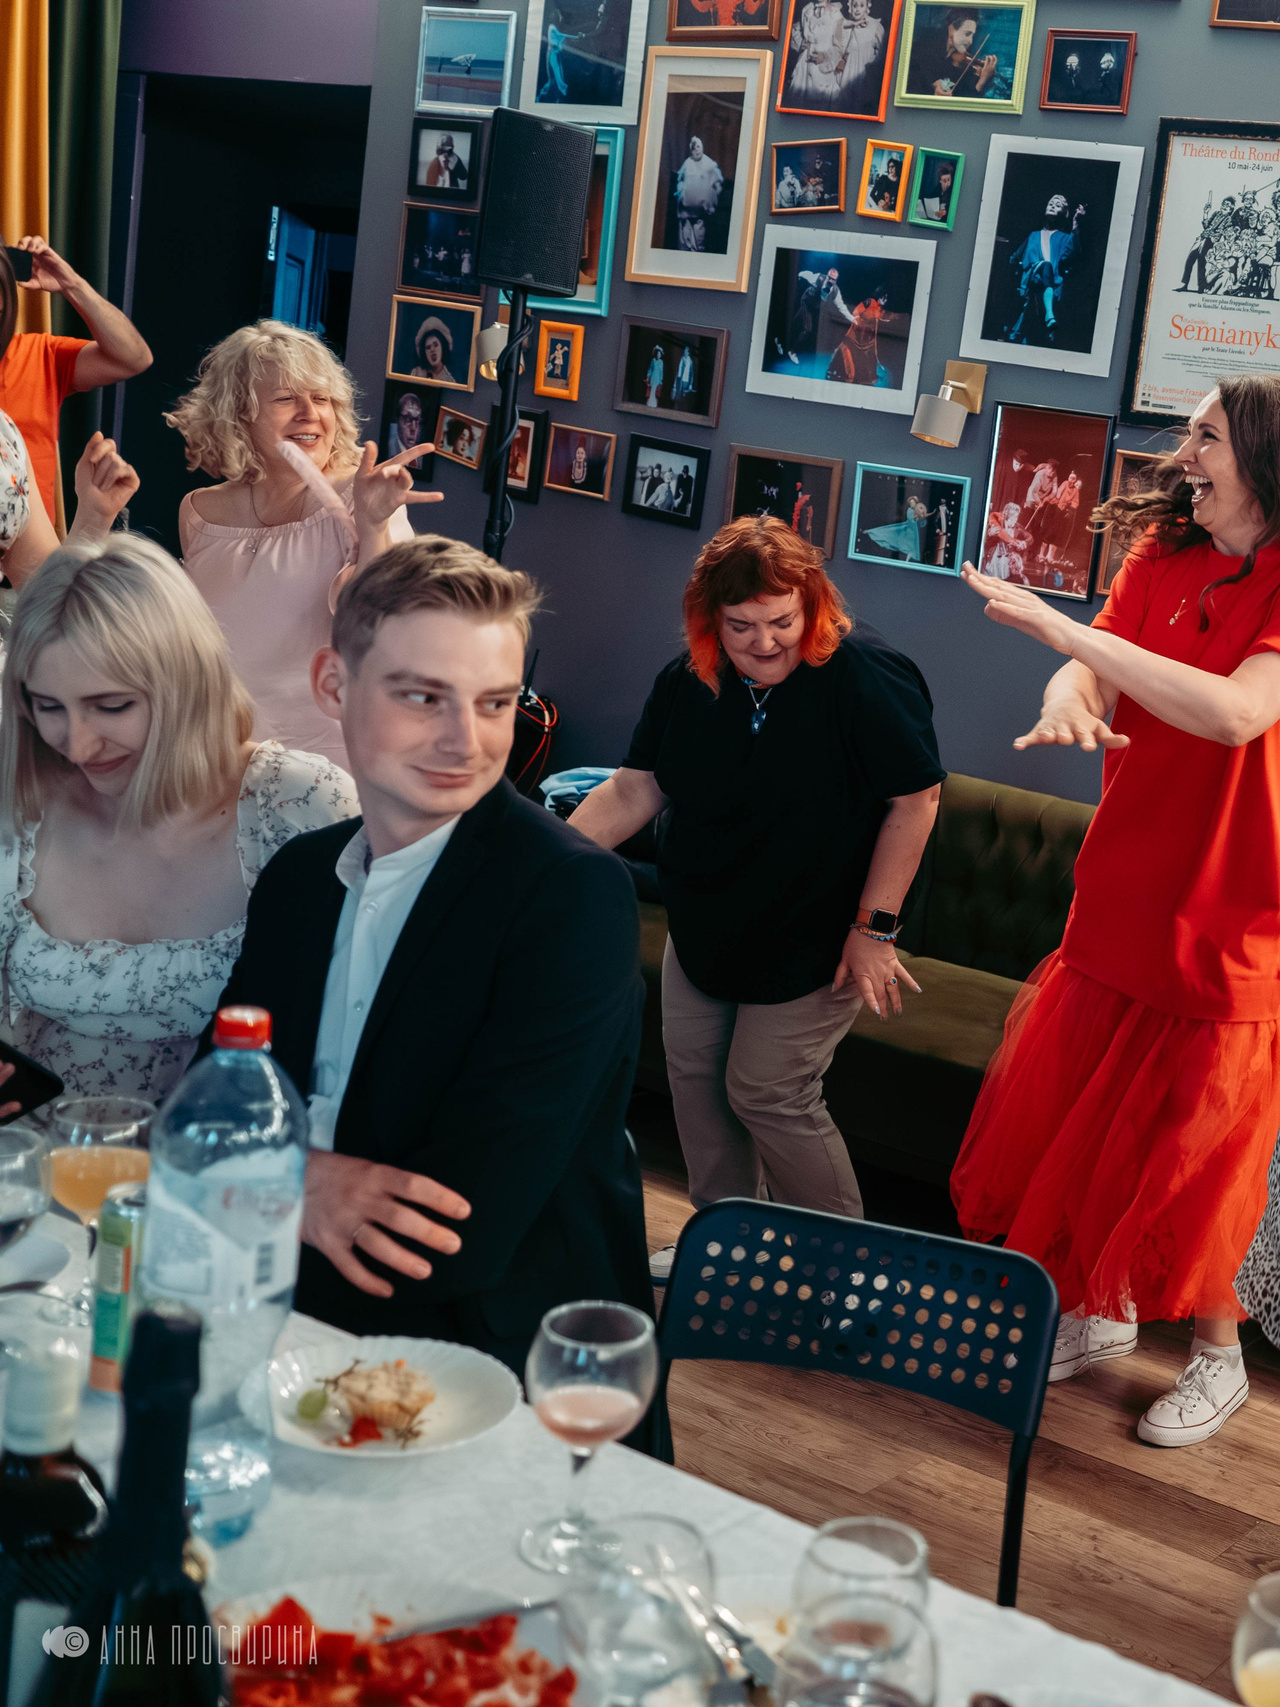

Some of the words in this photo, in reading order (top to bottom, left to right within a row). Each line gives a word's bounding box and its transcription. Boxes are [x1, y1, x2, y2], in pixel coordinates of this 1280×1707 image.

[1181, 142, 1227, 159] Théâtre
[1229, 146, 1245, 160] du
[1227, 162, 1236, 170] 10
[1260, 165, 1273, 173] juin
